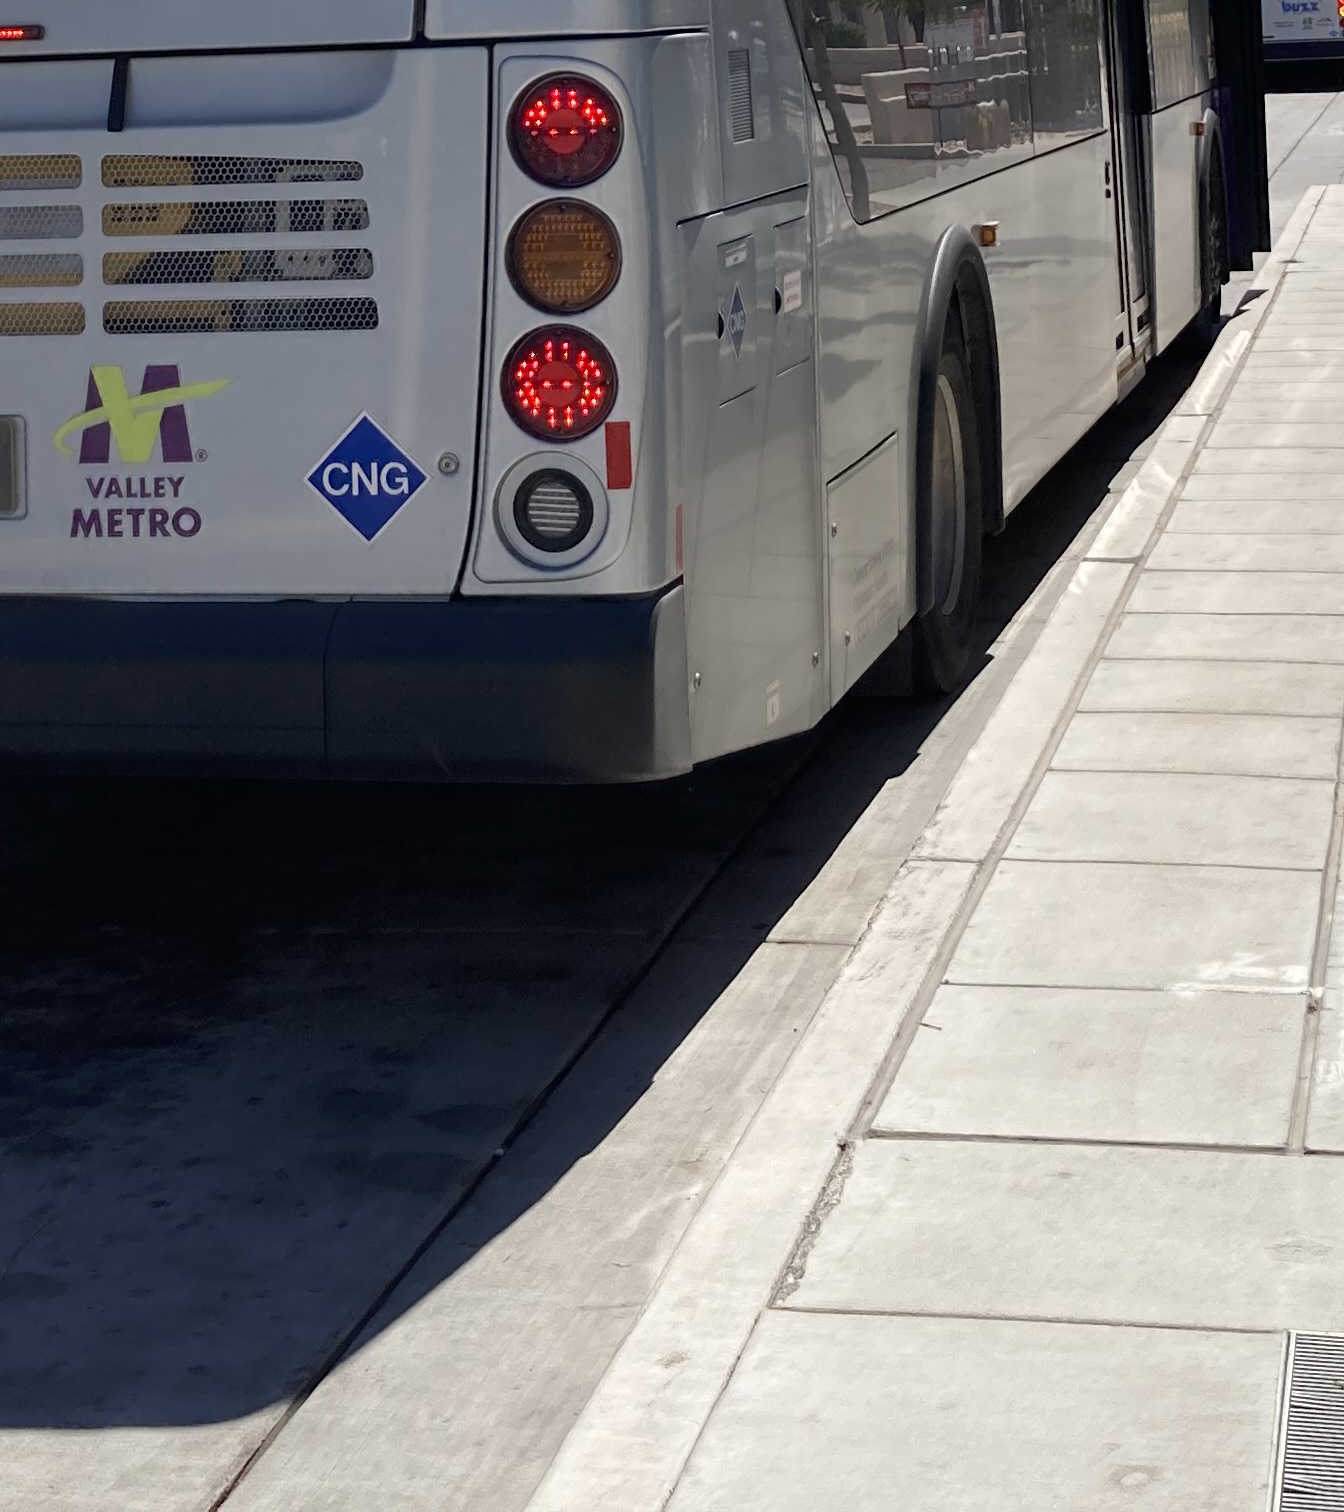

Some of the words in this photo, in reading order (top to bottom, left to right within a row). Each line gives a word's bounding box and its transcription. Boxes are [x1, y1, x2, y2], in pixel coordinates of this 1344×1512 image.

[85, 475, 185, 499] VALLEY
[321, 461, 410, 497] CNG
[69, 506, 202, 538] METRO
